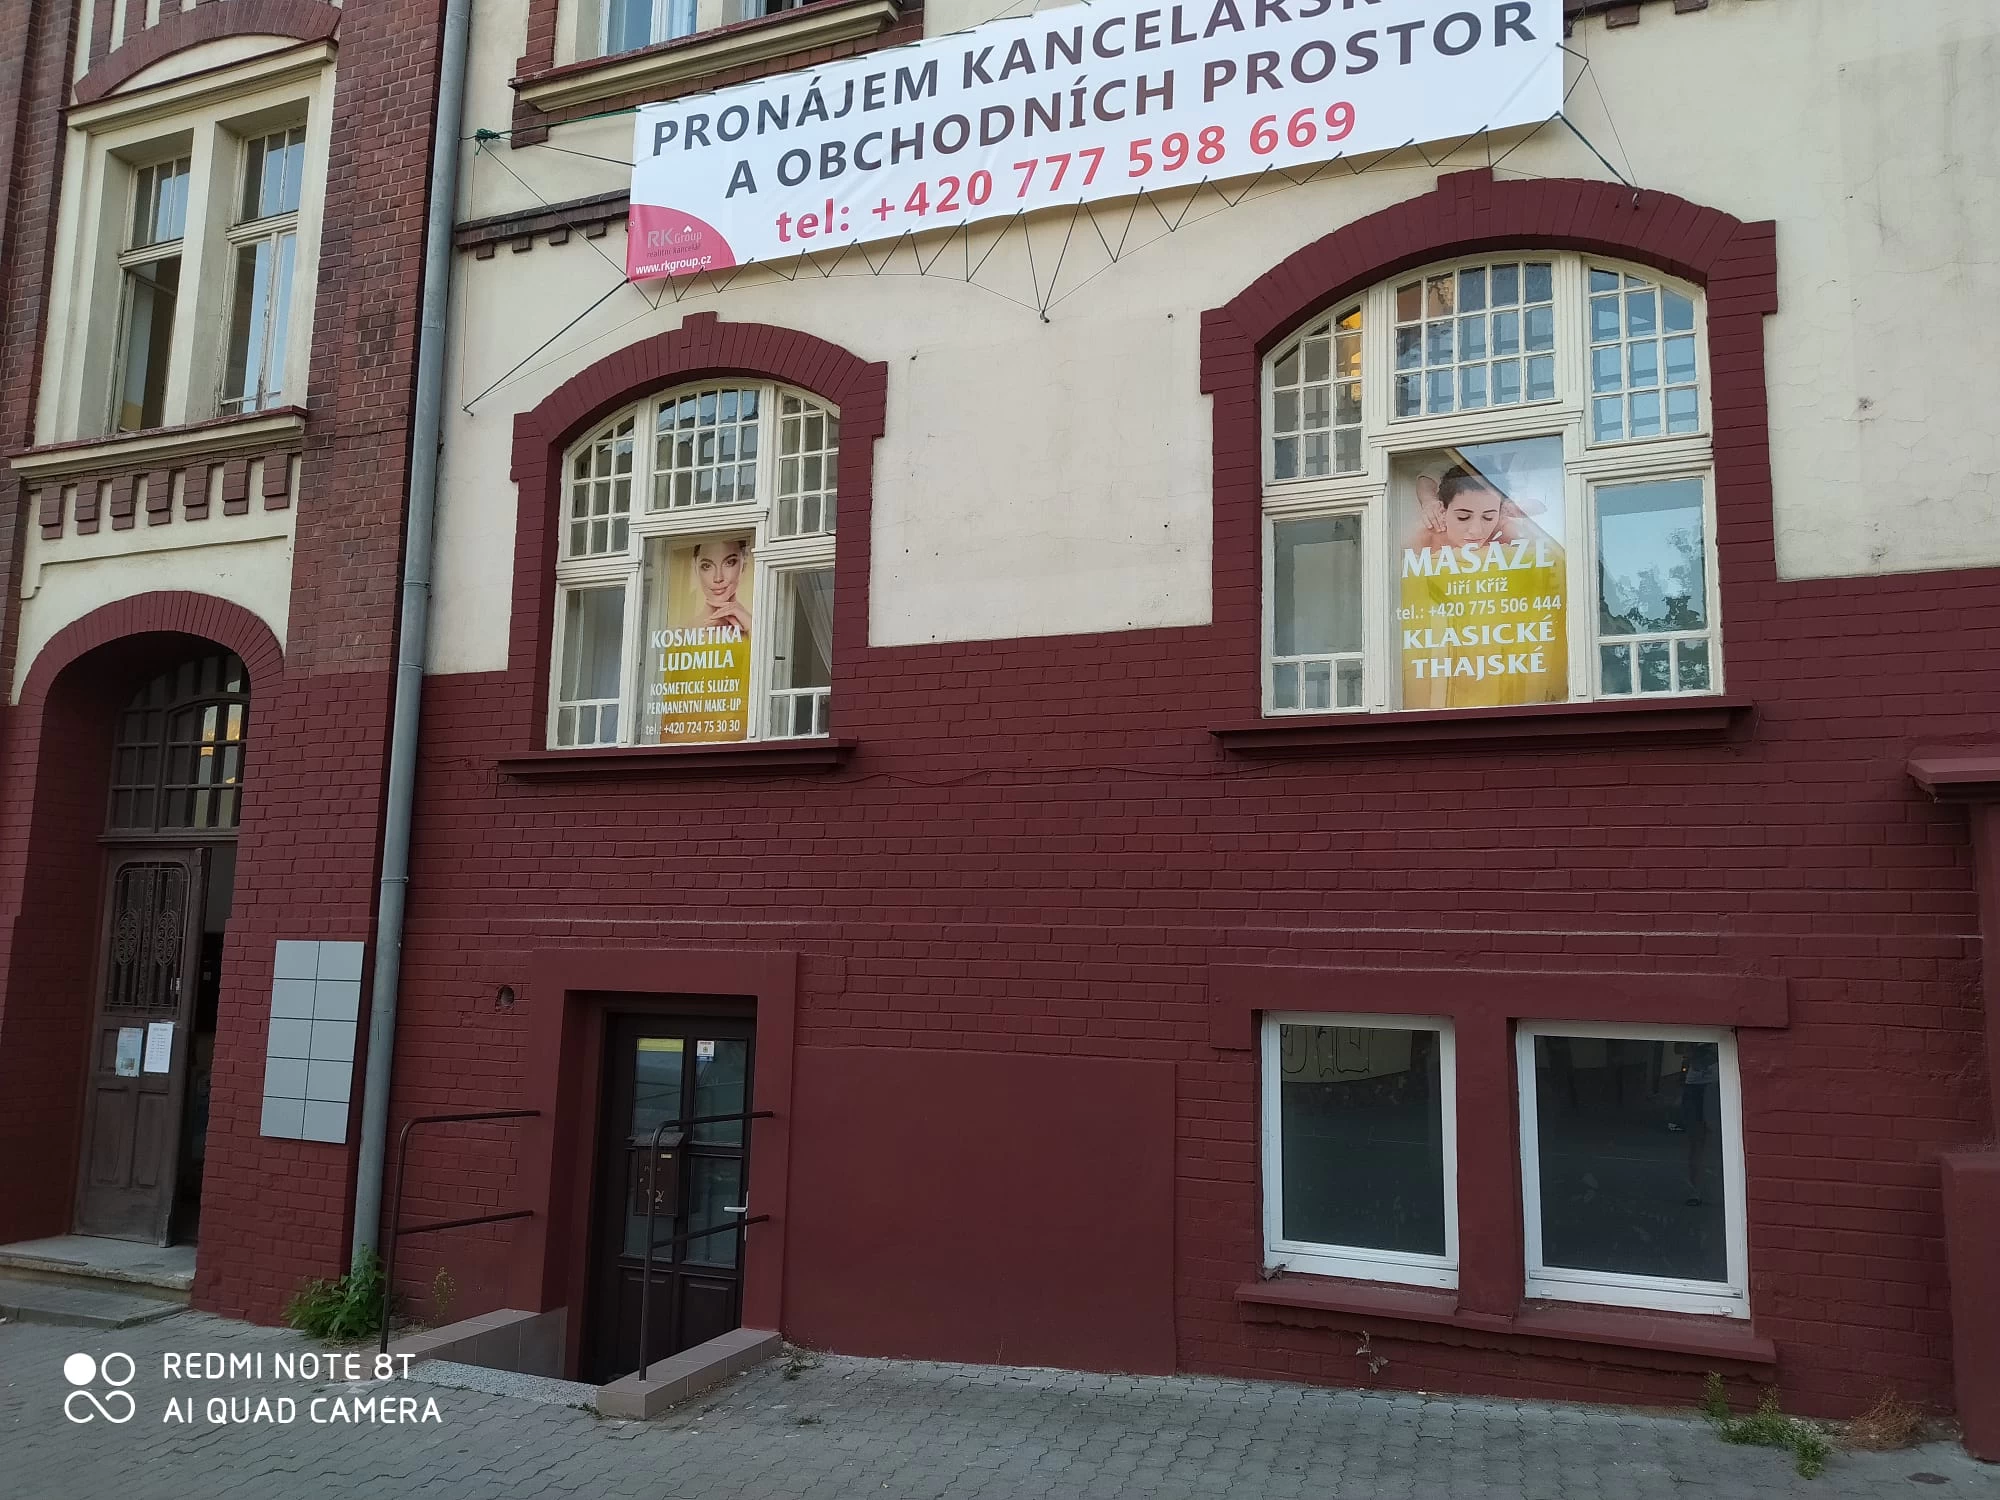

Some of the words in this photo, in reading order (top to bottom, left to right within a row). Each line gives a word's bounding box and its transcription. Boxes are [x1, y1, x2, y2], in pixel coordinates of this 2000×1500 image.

[652, 59, 938, 157] PRONÁJEM
[724, 159, 757, 199] A
[776, 69, 1175, 188] OBCHODNÍCH
[1203, 1, 1537, 104] PROSTOR
[775, 198, 849, 244] tel:
[871, 170, 993, 222] +420
[1013, 146, 1106, 199] 777
[1127, 126, 1226, 179] 598
[1249, 101, 1356, 155] 669
[647, 228, 673, 248] RK
[635, 255, 712, 274] www.rkgroup.cz
[1445, 580, 1471, 596] Jiří
[1476, 577, 1509, 594] Kříž
[1396, 604, 1424, 621] tel.:
[1428, 602, 1465, 617] +420
[1469, 600, 1496, 616] 775
[1500, 597, 1529, 614] 506
[1532, 595, 1562, 611] 444
[651, 624, 743, 649] KOSMETIKA
[1403, 615, 1556, 650] KLASICKÉ
[659, 650, 734, 672] LUDMILA
[1411, 645, 1547, 681] THAJSKÉ
[650, 677, 705, 696] KOSMETICKÉ
[707, 676, 740, 693] SLUŽBY
[647, 696, 702, 715] PERMANENTNÍ
[704, 698, 742, 713] MAKE-UP
[664, 722, 684, 734] +420
[687, 721, 701, 733] 724
[704, 720, 714, 733] 75
[716, 720, 727, 732] 30
[729, 719, 740, 732] 30
